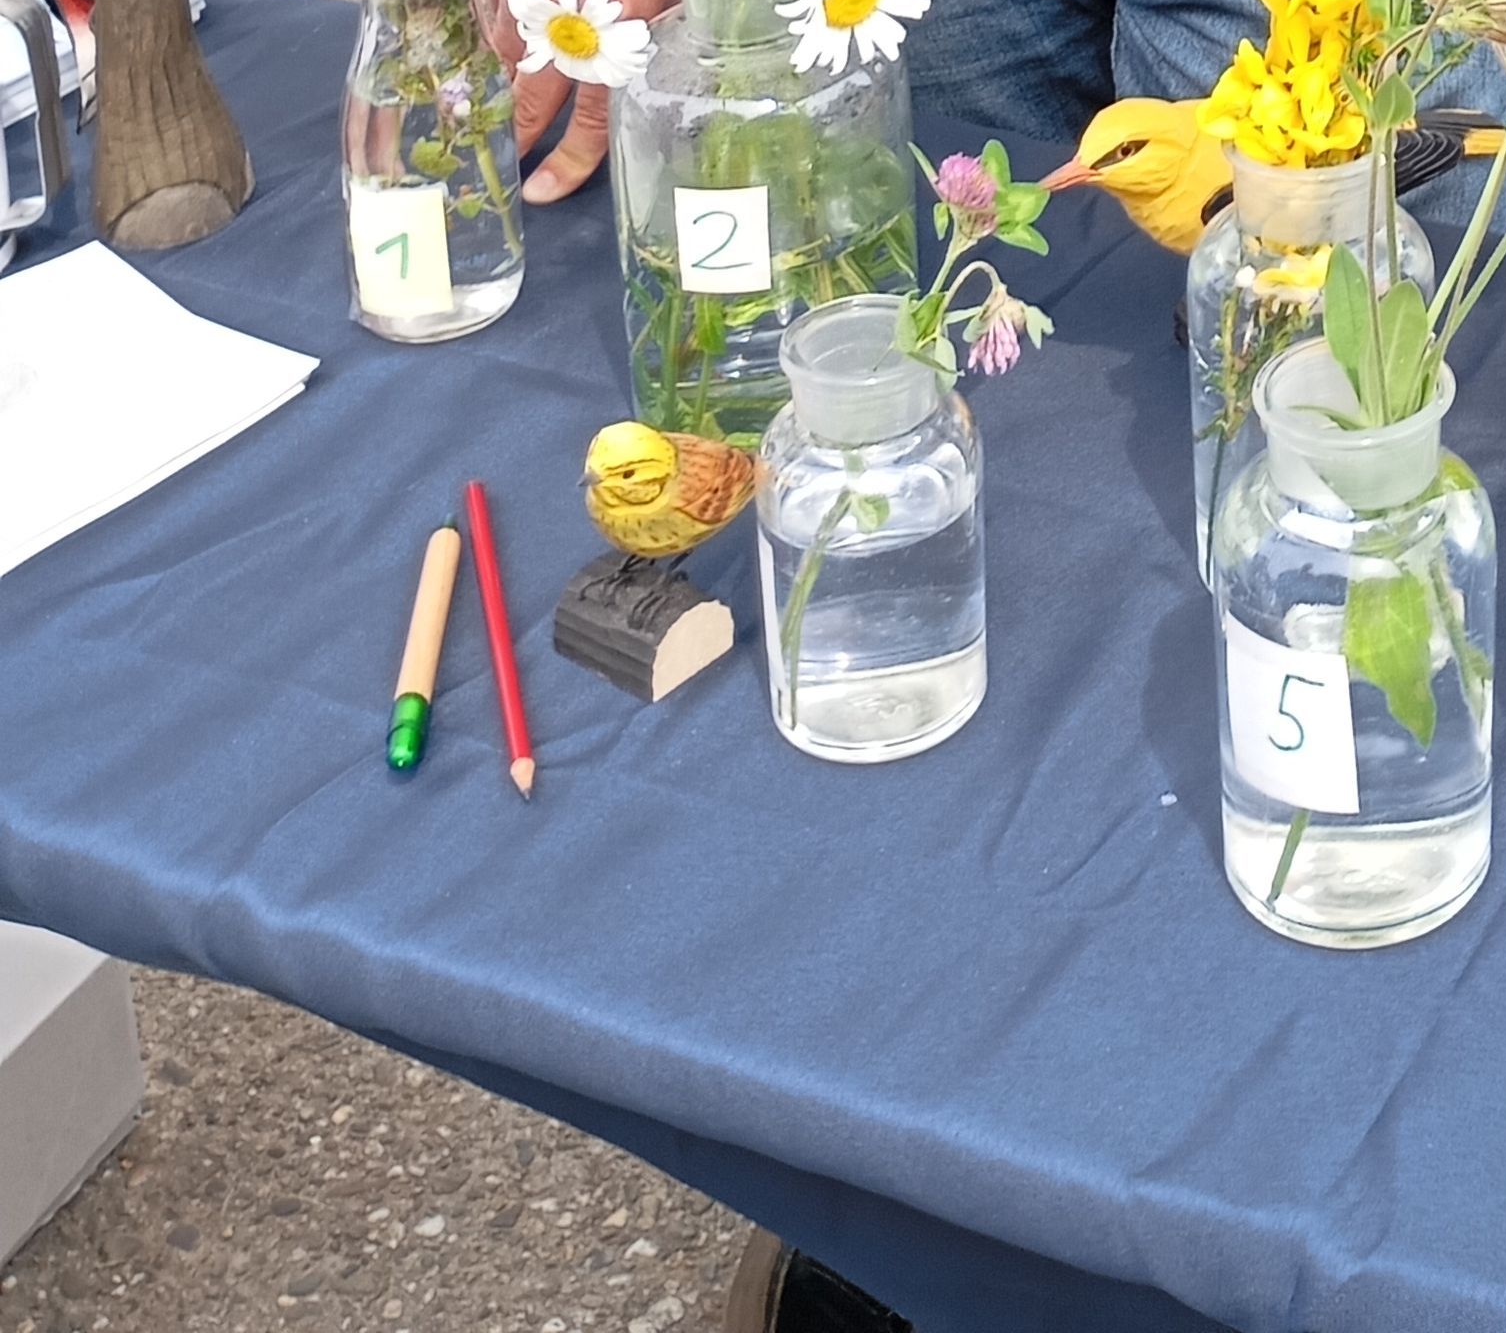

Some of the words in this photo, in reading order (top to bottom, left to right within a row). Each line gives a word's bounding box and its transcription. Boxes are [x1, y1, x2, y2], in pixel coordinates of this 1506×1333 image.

[375, 232, 408, 279] 1
[691, 211, 753, 270] 2
[1268, 673, 1325, 751] 5
